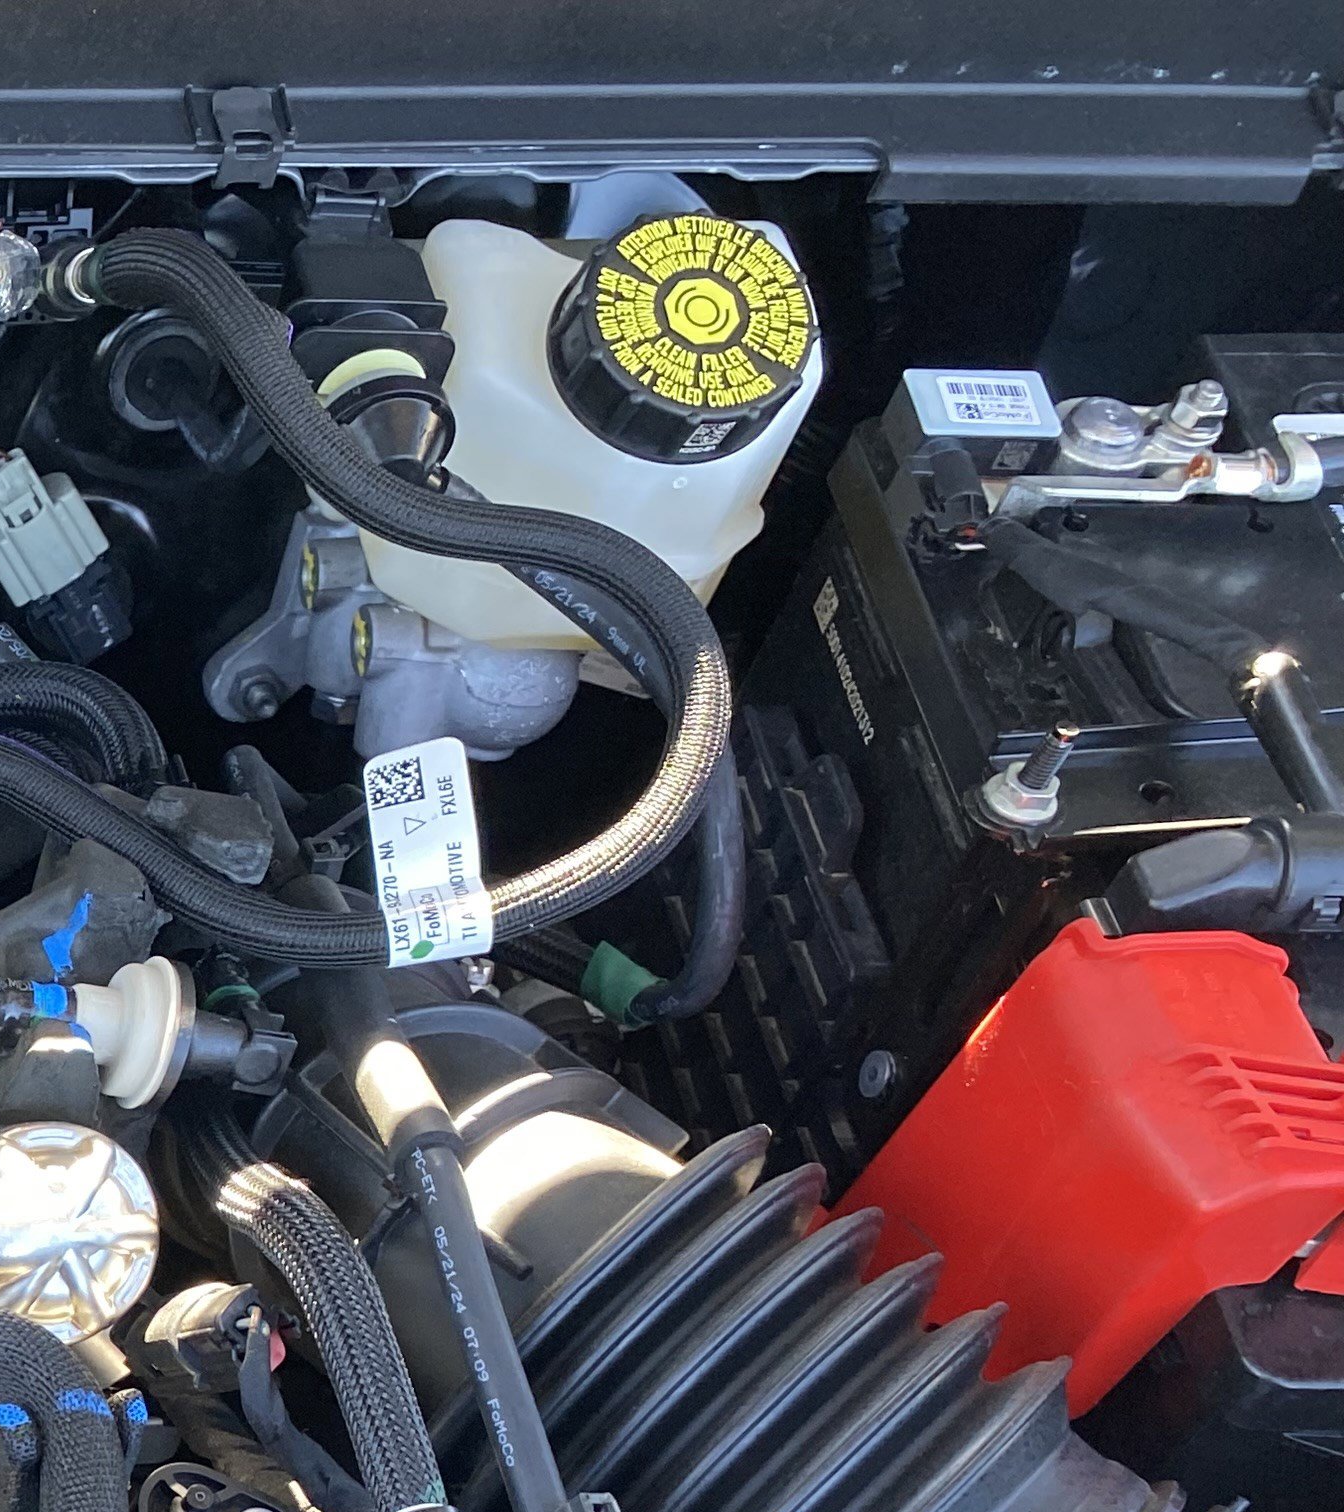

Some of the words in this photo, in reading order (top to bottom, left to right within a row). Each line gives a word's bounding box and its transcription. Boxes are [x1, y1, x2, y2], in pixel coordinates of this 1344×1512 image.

[695, 233, 719, 254] QUE
[718, 237, 734, 256] DU
[597, 266, 620, 295] DOT
[616, 218, 673, 260] ATTENTION
[674, 215, 735, 239] NETTOYER
[734, 229, 755, 247] LE
[751, 237, 797, 287] BOUCHON
[784, 286, 809, 324] AVANT
[648, 251, 713, 285] PROVENANT
[735, 244, 774, 292] LIQUIDE
[616, 272, 641, 301] CAP
[764, 283, 785, 300] DE
[596, 304, 622, 341] FLUID
[614, 300, 646, 346] BEFORE
[634, 281, 662, 340] WARNING
[654, 336, 698, 370] CLEAN
[701, 345, 749, 371] FILLER
[768, 298, 791, 330] FREIN
[609, 340, 643, 376] FROM
[633, 342, 696, 388] REMOVING
[728, 359, 760, 387] ONLY
[638, 369, 652, 387] A
[652, 376, 703, 407] SEALED
[698, 370, 725, 391] USE
[706, 373, 777, 408] CONTAINER
[437, 774, 459, 817] FXL6E
[462, 925, 478, 941] TI
[434, 1224, 467, 1314] 05/21/24
[486, 1397, 515, 1468] FoMoCo
